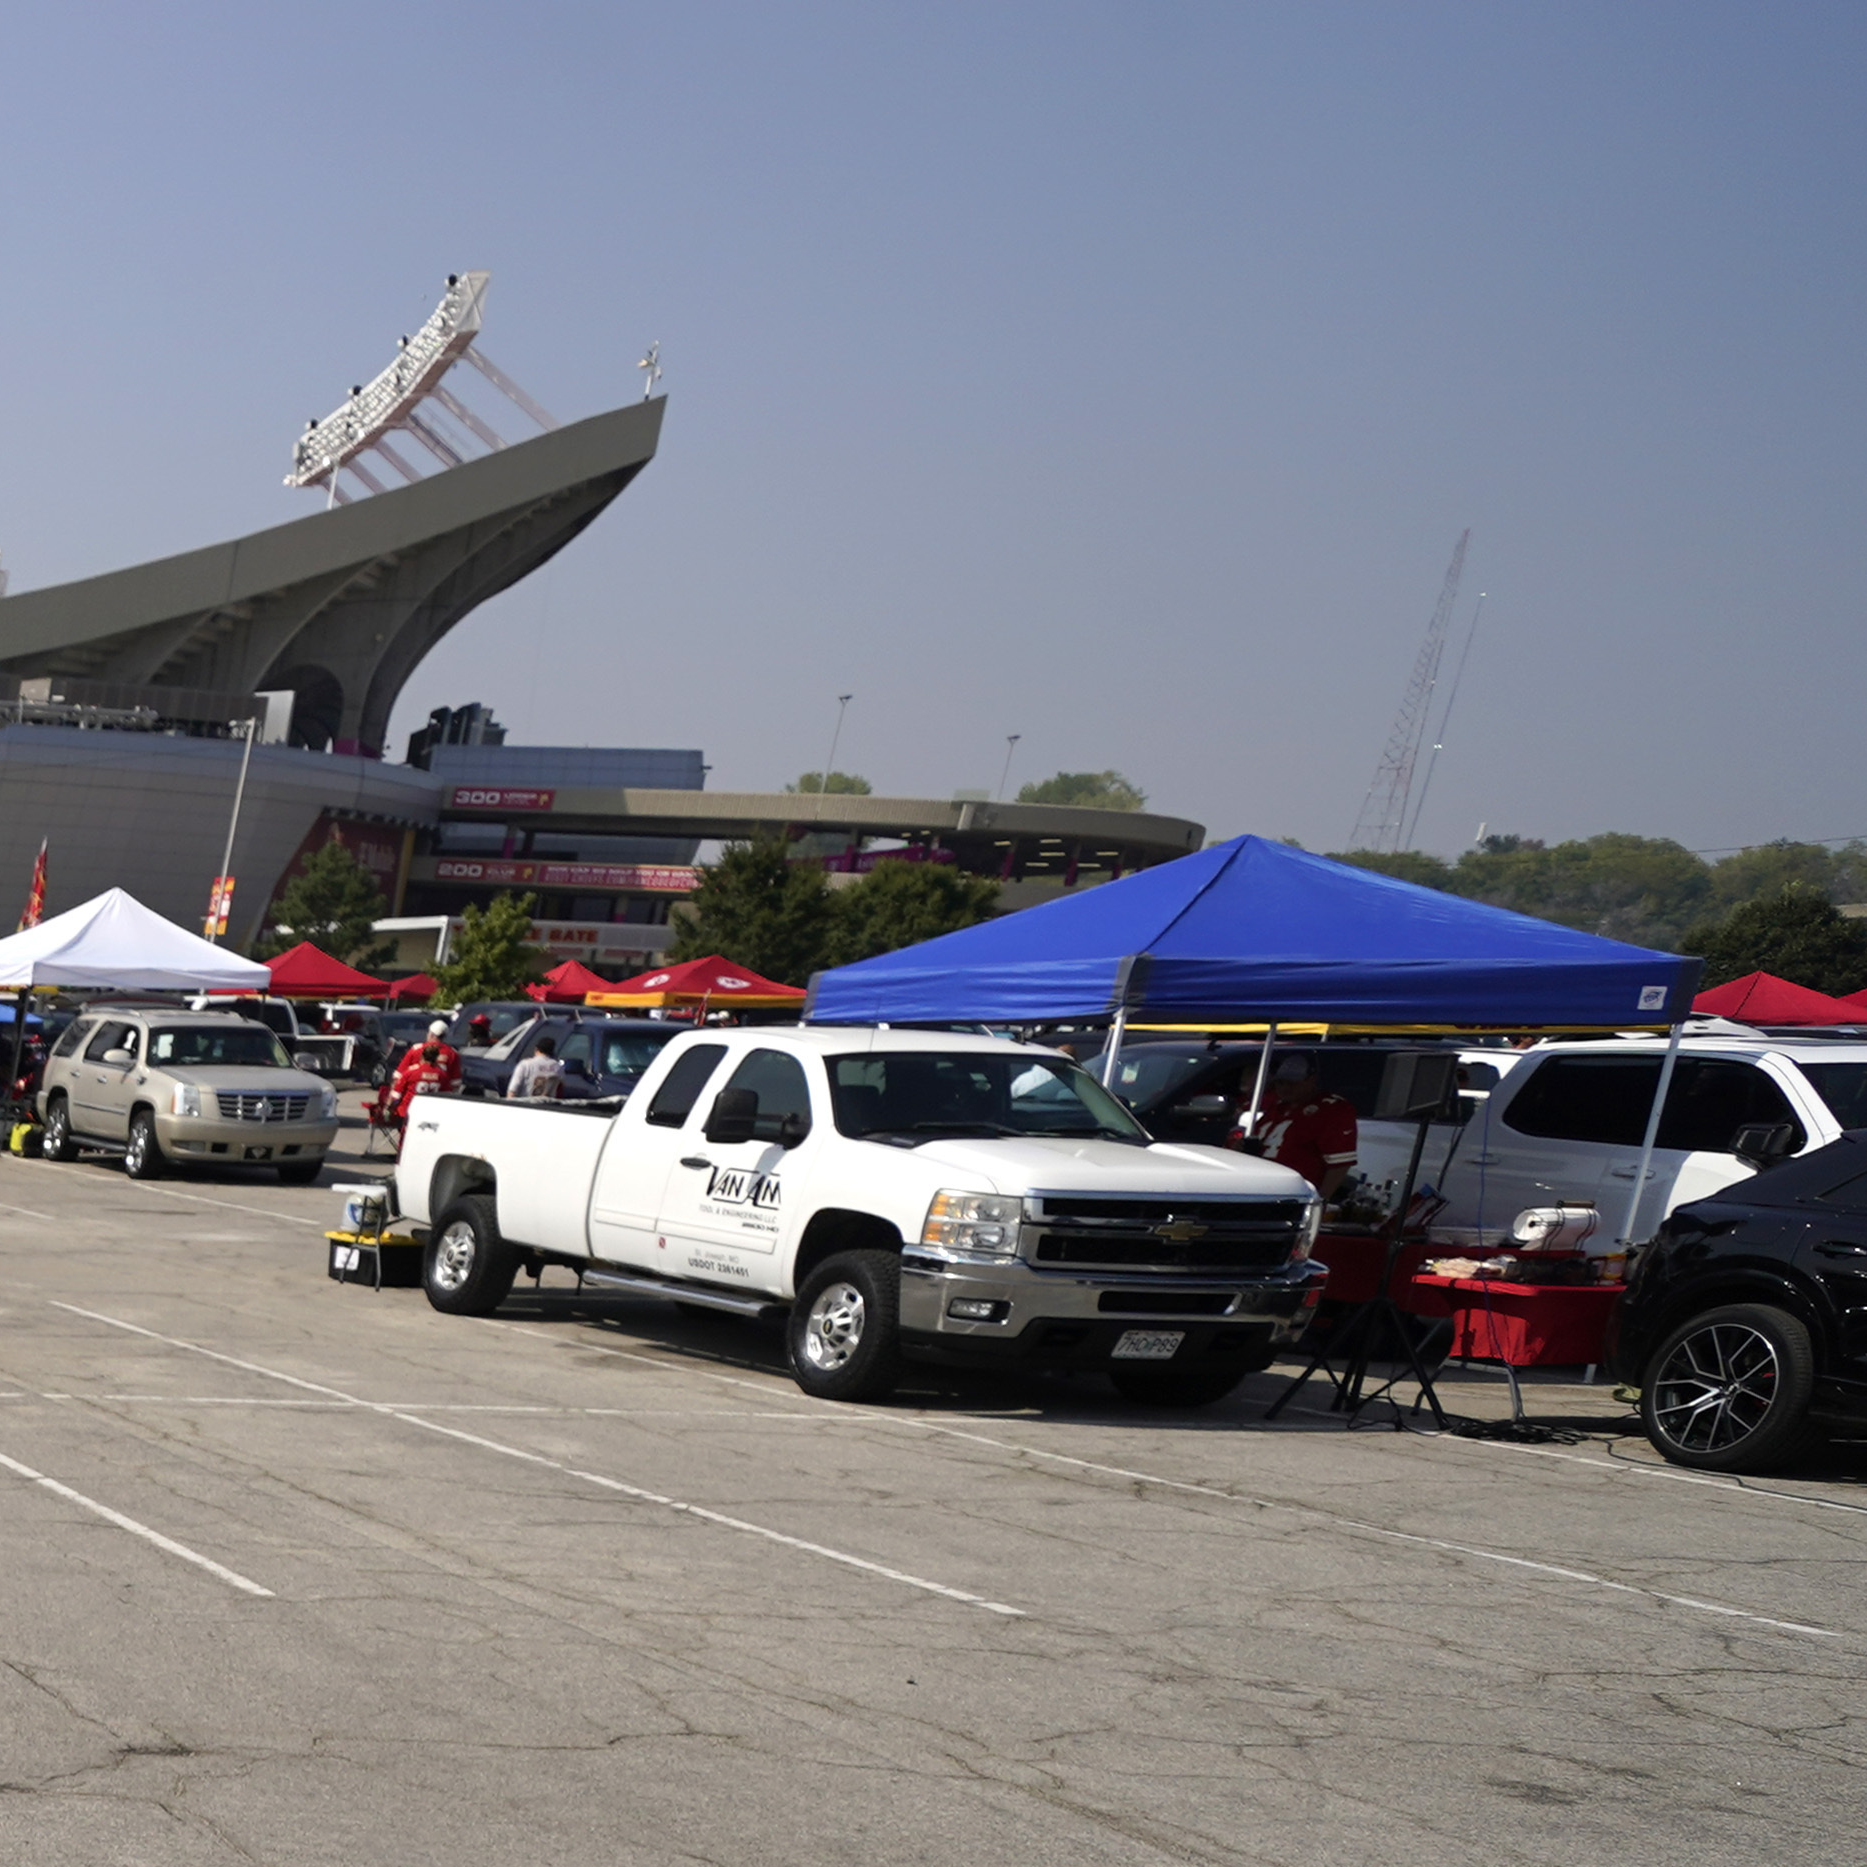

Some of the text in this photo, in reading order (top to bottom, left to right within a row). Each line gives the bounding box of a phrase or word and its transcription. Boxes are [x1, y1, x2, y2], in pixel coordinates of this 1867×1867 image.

[455, 790, 502, 805] 300
[438, 862, 484, 877] 200
[547, 927, 599, 943] GATE
[706, 1165, 782, 1207] VAN AM
[722, 1207, 763, 1221] ENGINEERING
[688, 1257, 716, 1272] USDOT
